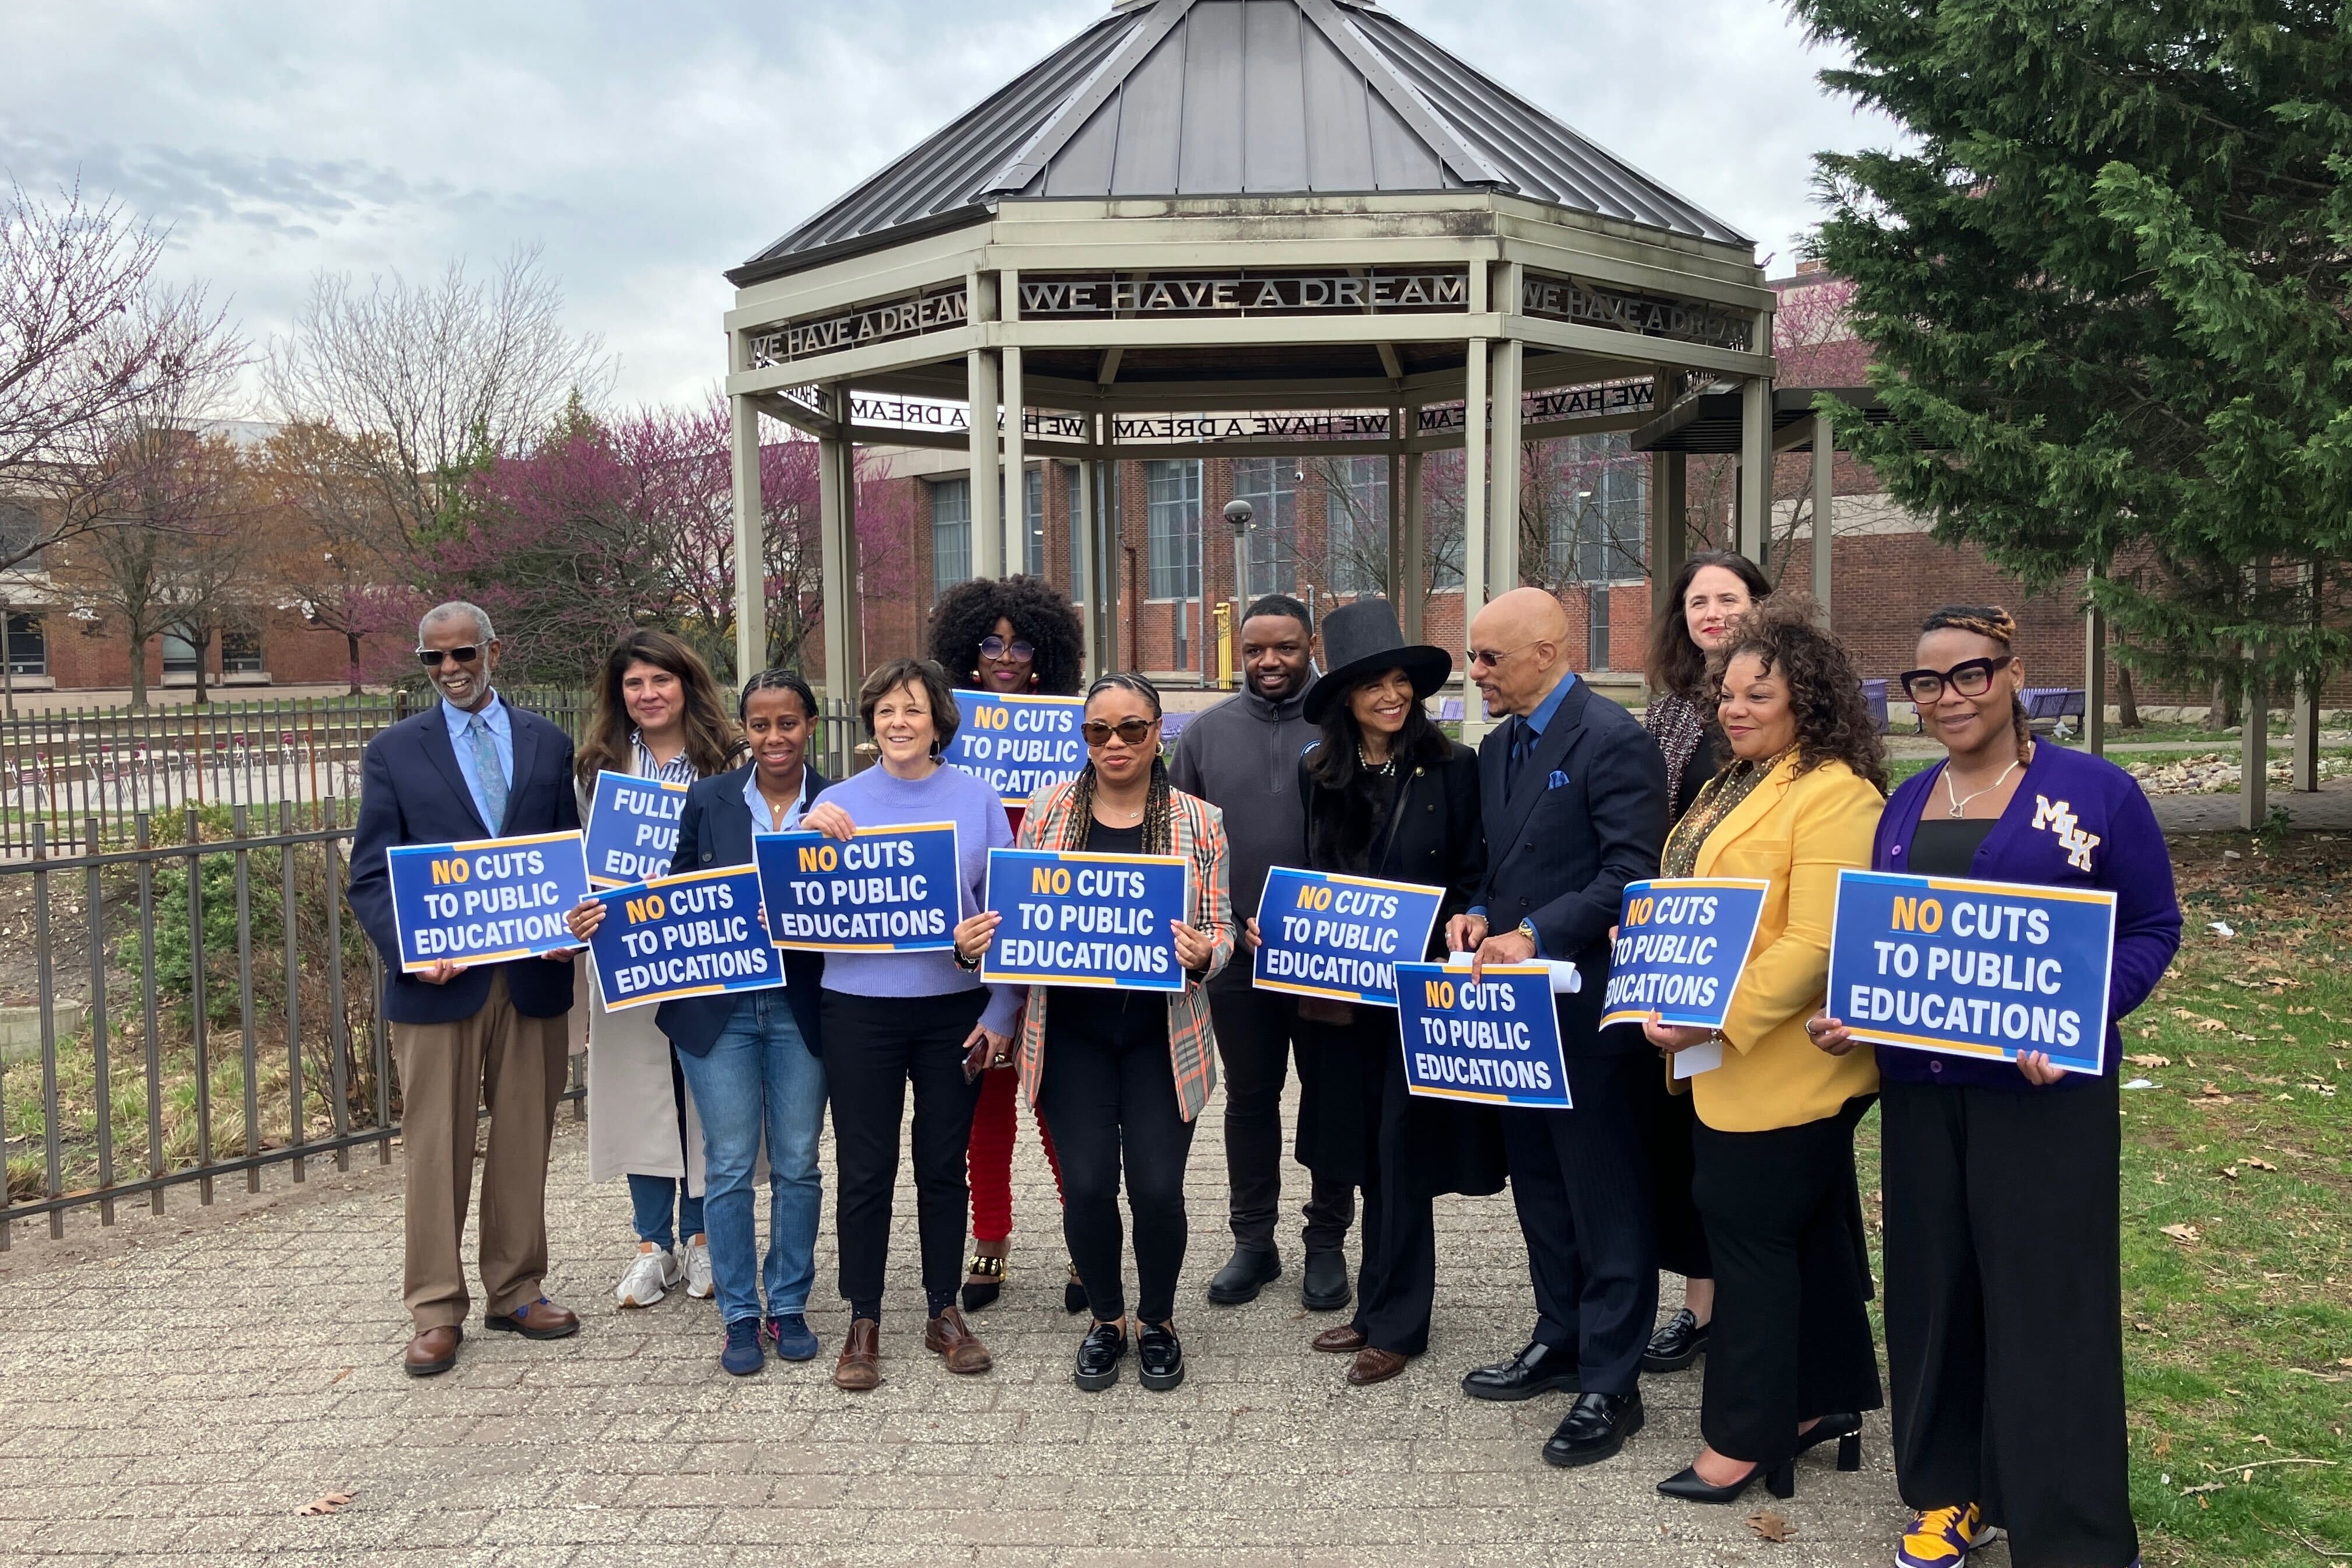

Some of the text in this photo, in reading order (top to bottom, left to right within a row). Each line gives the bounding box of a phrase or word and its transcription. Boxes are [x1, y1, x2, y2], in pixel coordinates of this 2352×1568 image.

[1021, 275, 1466, 312] WE HAVE A DREAM
[1522, 280, 1561, 313] WE
[1569, 288, 1642, 328] HAVE
[1647, 302, 1664, 330] A
[748, 332, 784, 365] WE
[789, 317, 853, 355] HAVE
[858, 313, 877, 341] A
[974, 706, 1073, 733] NO CUTS
[961, 736, 1079, 764] TO PUBLIC
[613, 788, 686, 821] FULLY
[2032, 794, 2101, 872] MLK
[431, 850, 544, 886] NO CUTS
[799, 841, 915, 873] NO CUTS
[424, 881, 559, 919] TO PUBLIC
[790, 874, 928, 906] TO PUBLIC
[1032, 868, 1146, 899] NO CUTS
[626, 884, 734, 925] NO CUTS
[1019, 903, 1154, 935] TO PUBLIC
[1296, 886, 1398, 919] NO CUTS
[1625, 896, 1718, 927] NO CUTS
[622, 916, 748, 958] TO PUBLIC
[781, 908, 945, 938] EDUCATIONS
[1283, 916, 1399, 954] TO PUBLIC
[1892, 897, 2049, 945] NO CUTS
[1000, 939, 1168, 974] EDUCATIONS
[1614, 935, 1717, 967] TO PUBLIC
[1874, 940, 2062, 995] TO PUBLIC
[615, 948, 768, 994] EDUCATIONS
[1266, 949, 1396, 990] EDUCATION
[1426, 981, 1516, 1012] NO CUTS
[1604, 974, 1718, 1009] EDUCATIONS
[1850, 985, 2081, 1047] EDUCATIONS
[1420, 1017, 1530, 1051] TO PUBLIC
[1415, 1053, 1552, 1090] EDUCATIONS
